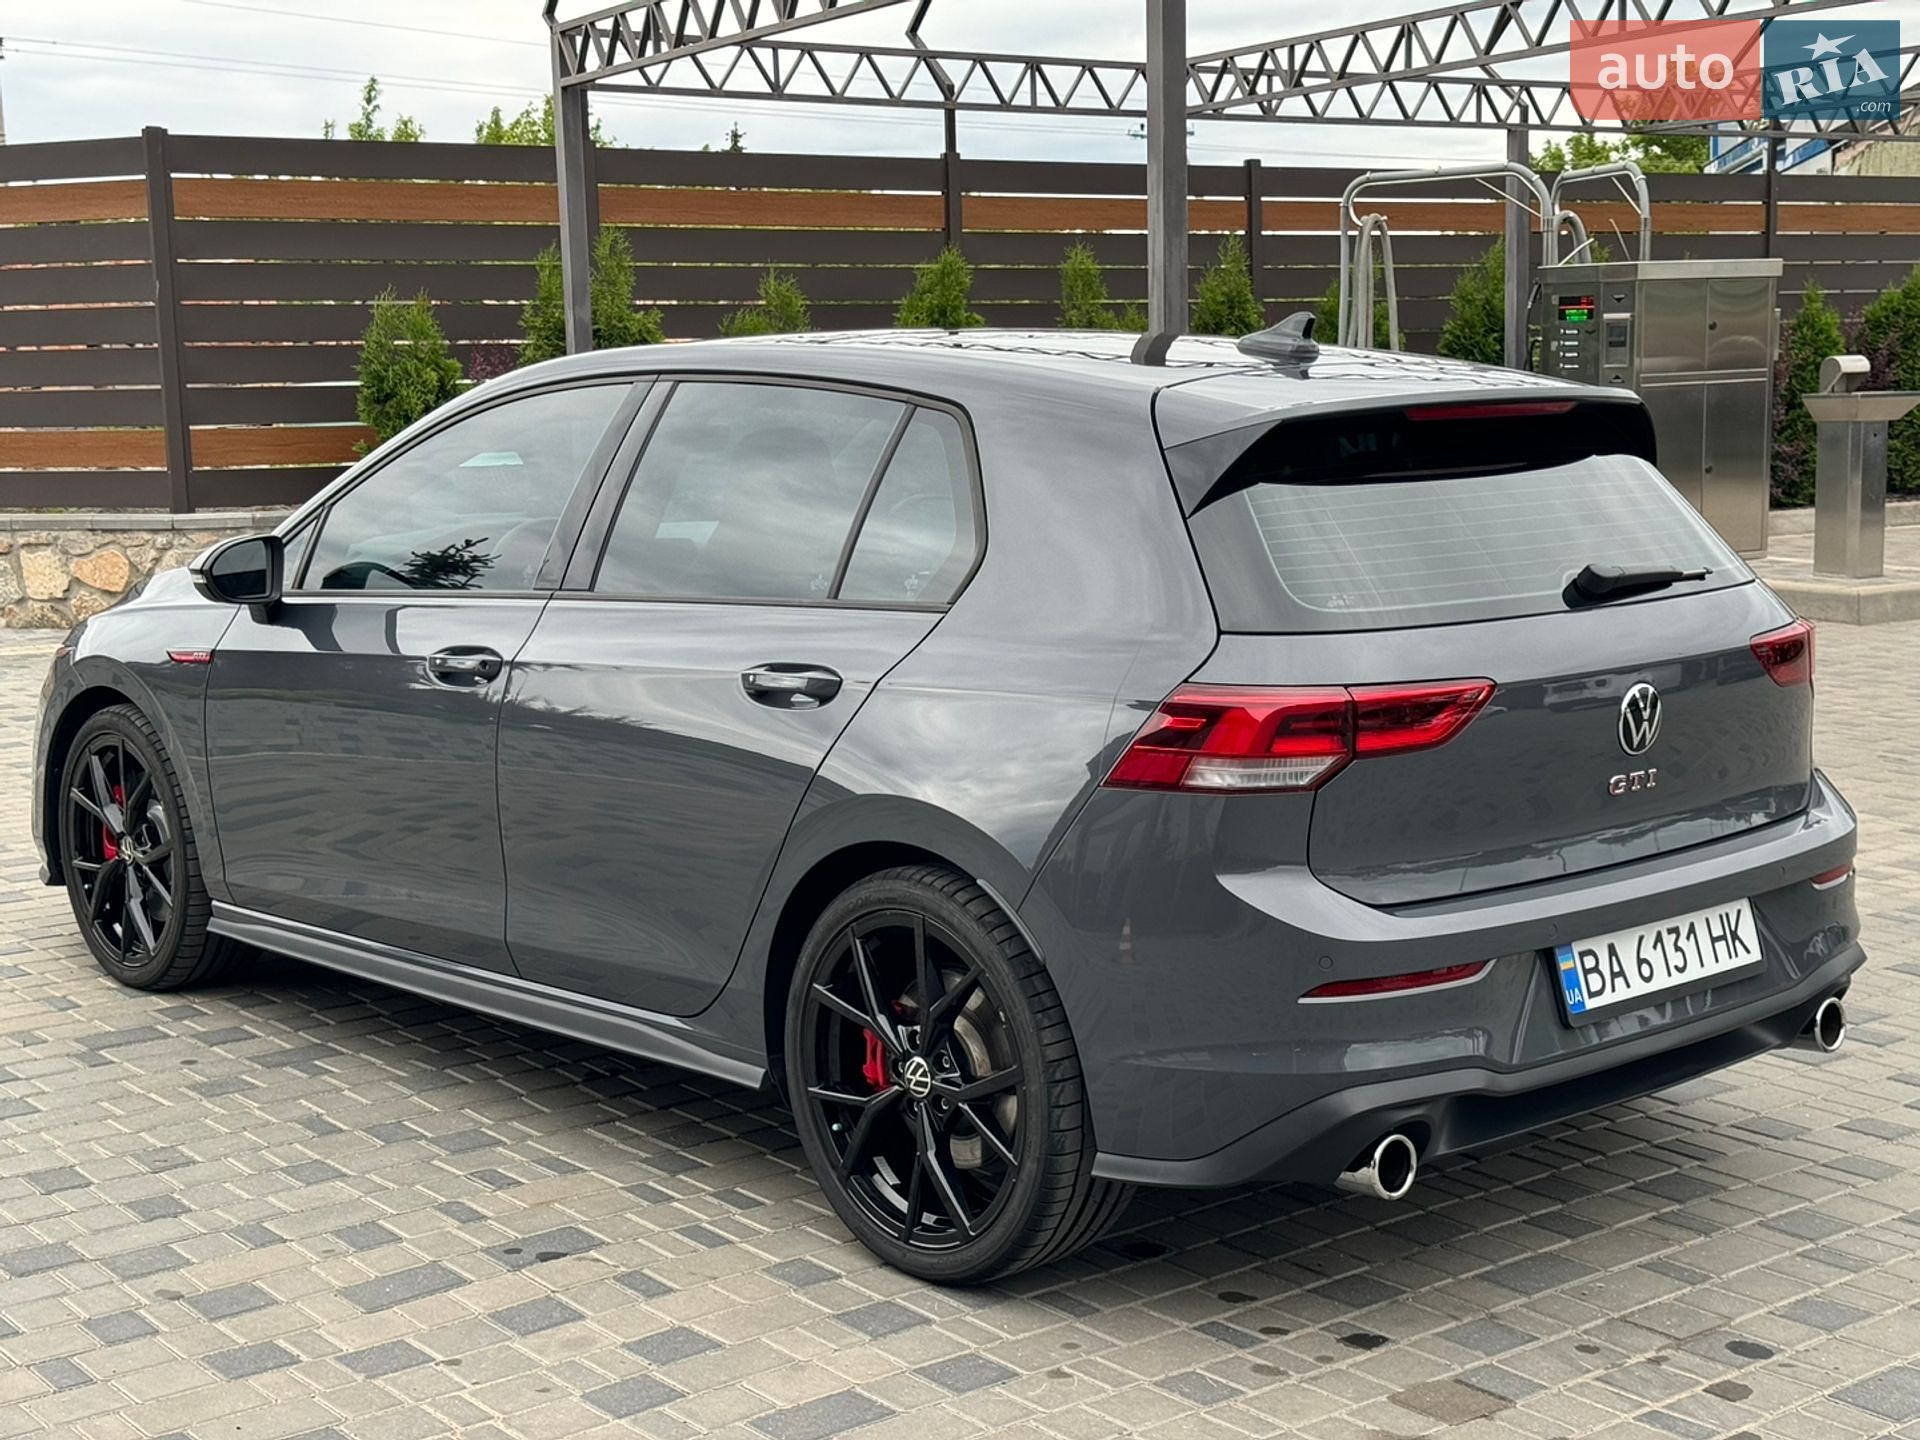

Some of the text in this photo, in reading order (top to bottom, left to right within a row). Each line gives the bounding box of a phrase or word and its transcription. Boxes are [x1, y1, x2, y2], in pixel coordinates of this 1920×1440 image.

[1609, 768, 1657, 795] GTI
[1578, 908, 1751, 999] BA 6131 HK
[1566, 987, 1583, 1004] UA
